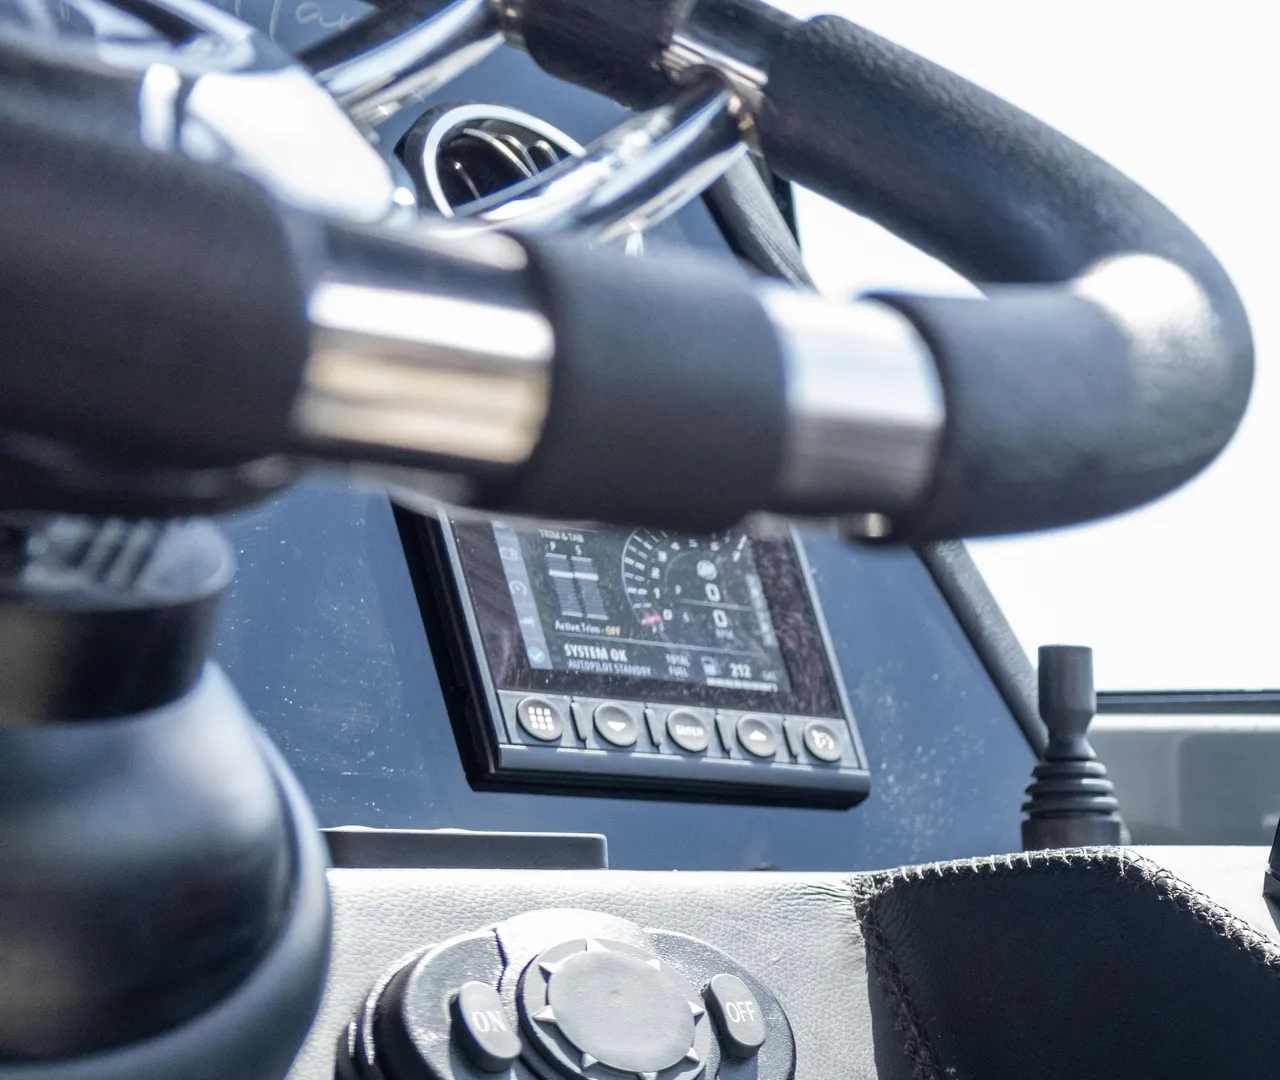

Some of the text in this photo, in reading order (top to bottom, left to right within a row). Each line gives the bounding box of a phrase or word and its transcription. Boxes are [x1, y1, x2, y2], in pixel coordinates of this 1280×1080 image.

[564, 643, 628, 662] SYSTEM OK
[471, 1011, 508, 1033] ON
[725, 1001, 755, 1024] OFF
